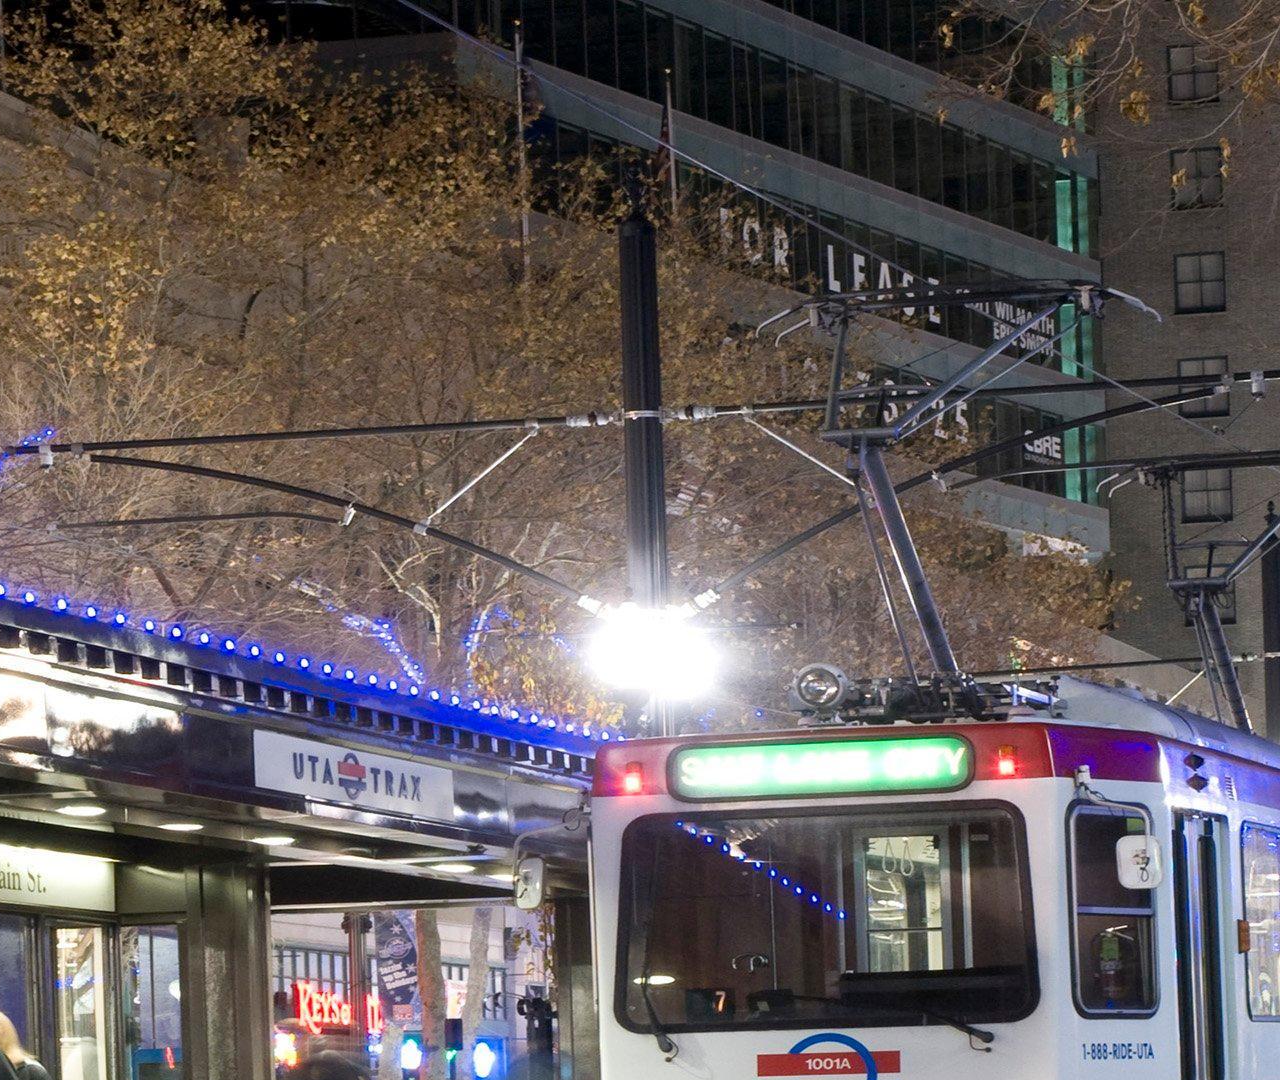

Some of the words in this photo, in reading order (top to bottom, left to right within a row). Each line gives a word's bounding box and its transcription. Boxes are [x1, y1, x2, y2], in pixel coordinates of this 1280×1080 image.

[292, 752, 334, 785] UTA
[370, 768, 421, 801] TRAX
[27, 866, 46, 893] St.
[1081, 1043, 1155, 1060] 1-888-RIDE-UTA
[805, 1058, 852, 1070] 1001A
